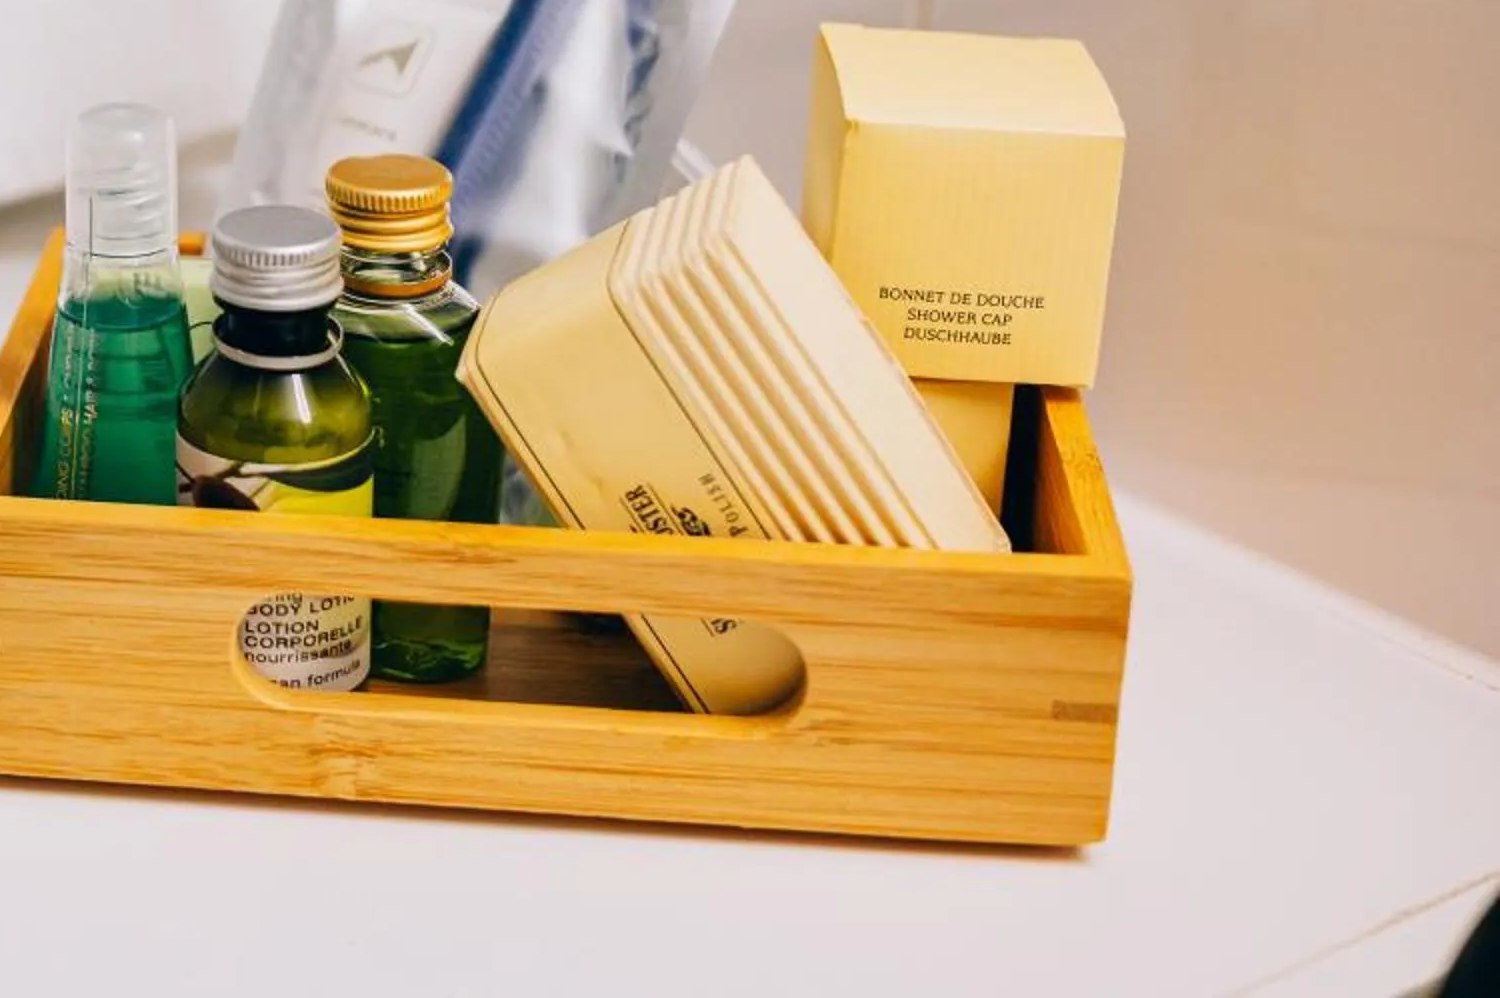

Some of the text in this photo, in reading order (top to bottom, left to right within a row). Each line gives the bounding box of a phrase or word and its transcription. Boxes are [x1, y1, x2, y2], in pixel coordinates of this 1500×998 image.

[879, 287, 1045, 309] BONNET DE DOUCHE
[907, 307, 1013, 327] SHOWER CAP
[903, 327, 1013, 345] DUSCHHAUBE
[699, 473, 748, 537] POLISH
[244, 614, 363, 649] CORPORELLE
[245, 619, 319, 635] LOTION
[244, 639, 353, 663] nourrissante
